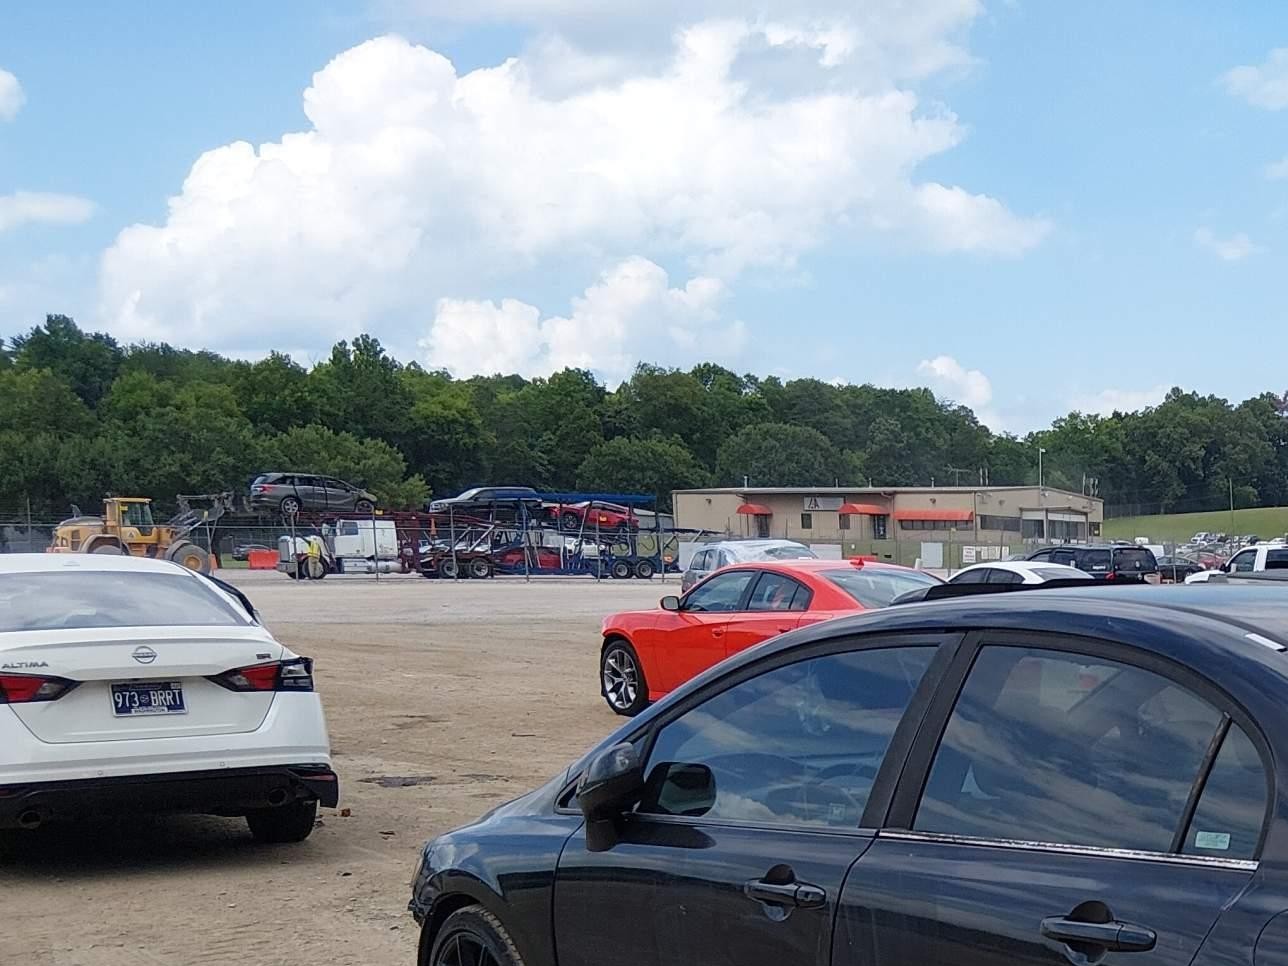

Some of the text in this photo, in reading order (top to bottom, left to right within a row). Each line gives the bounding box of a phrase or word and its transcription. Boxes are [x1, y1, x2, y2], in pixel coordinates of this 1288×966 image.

[2, 661, 49, 669] ALTIMA
[114, 689, 182, 708] 973 BRRT
